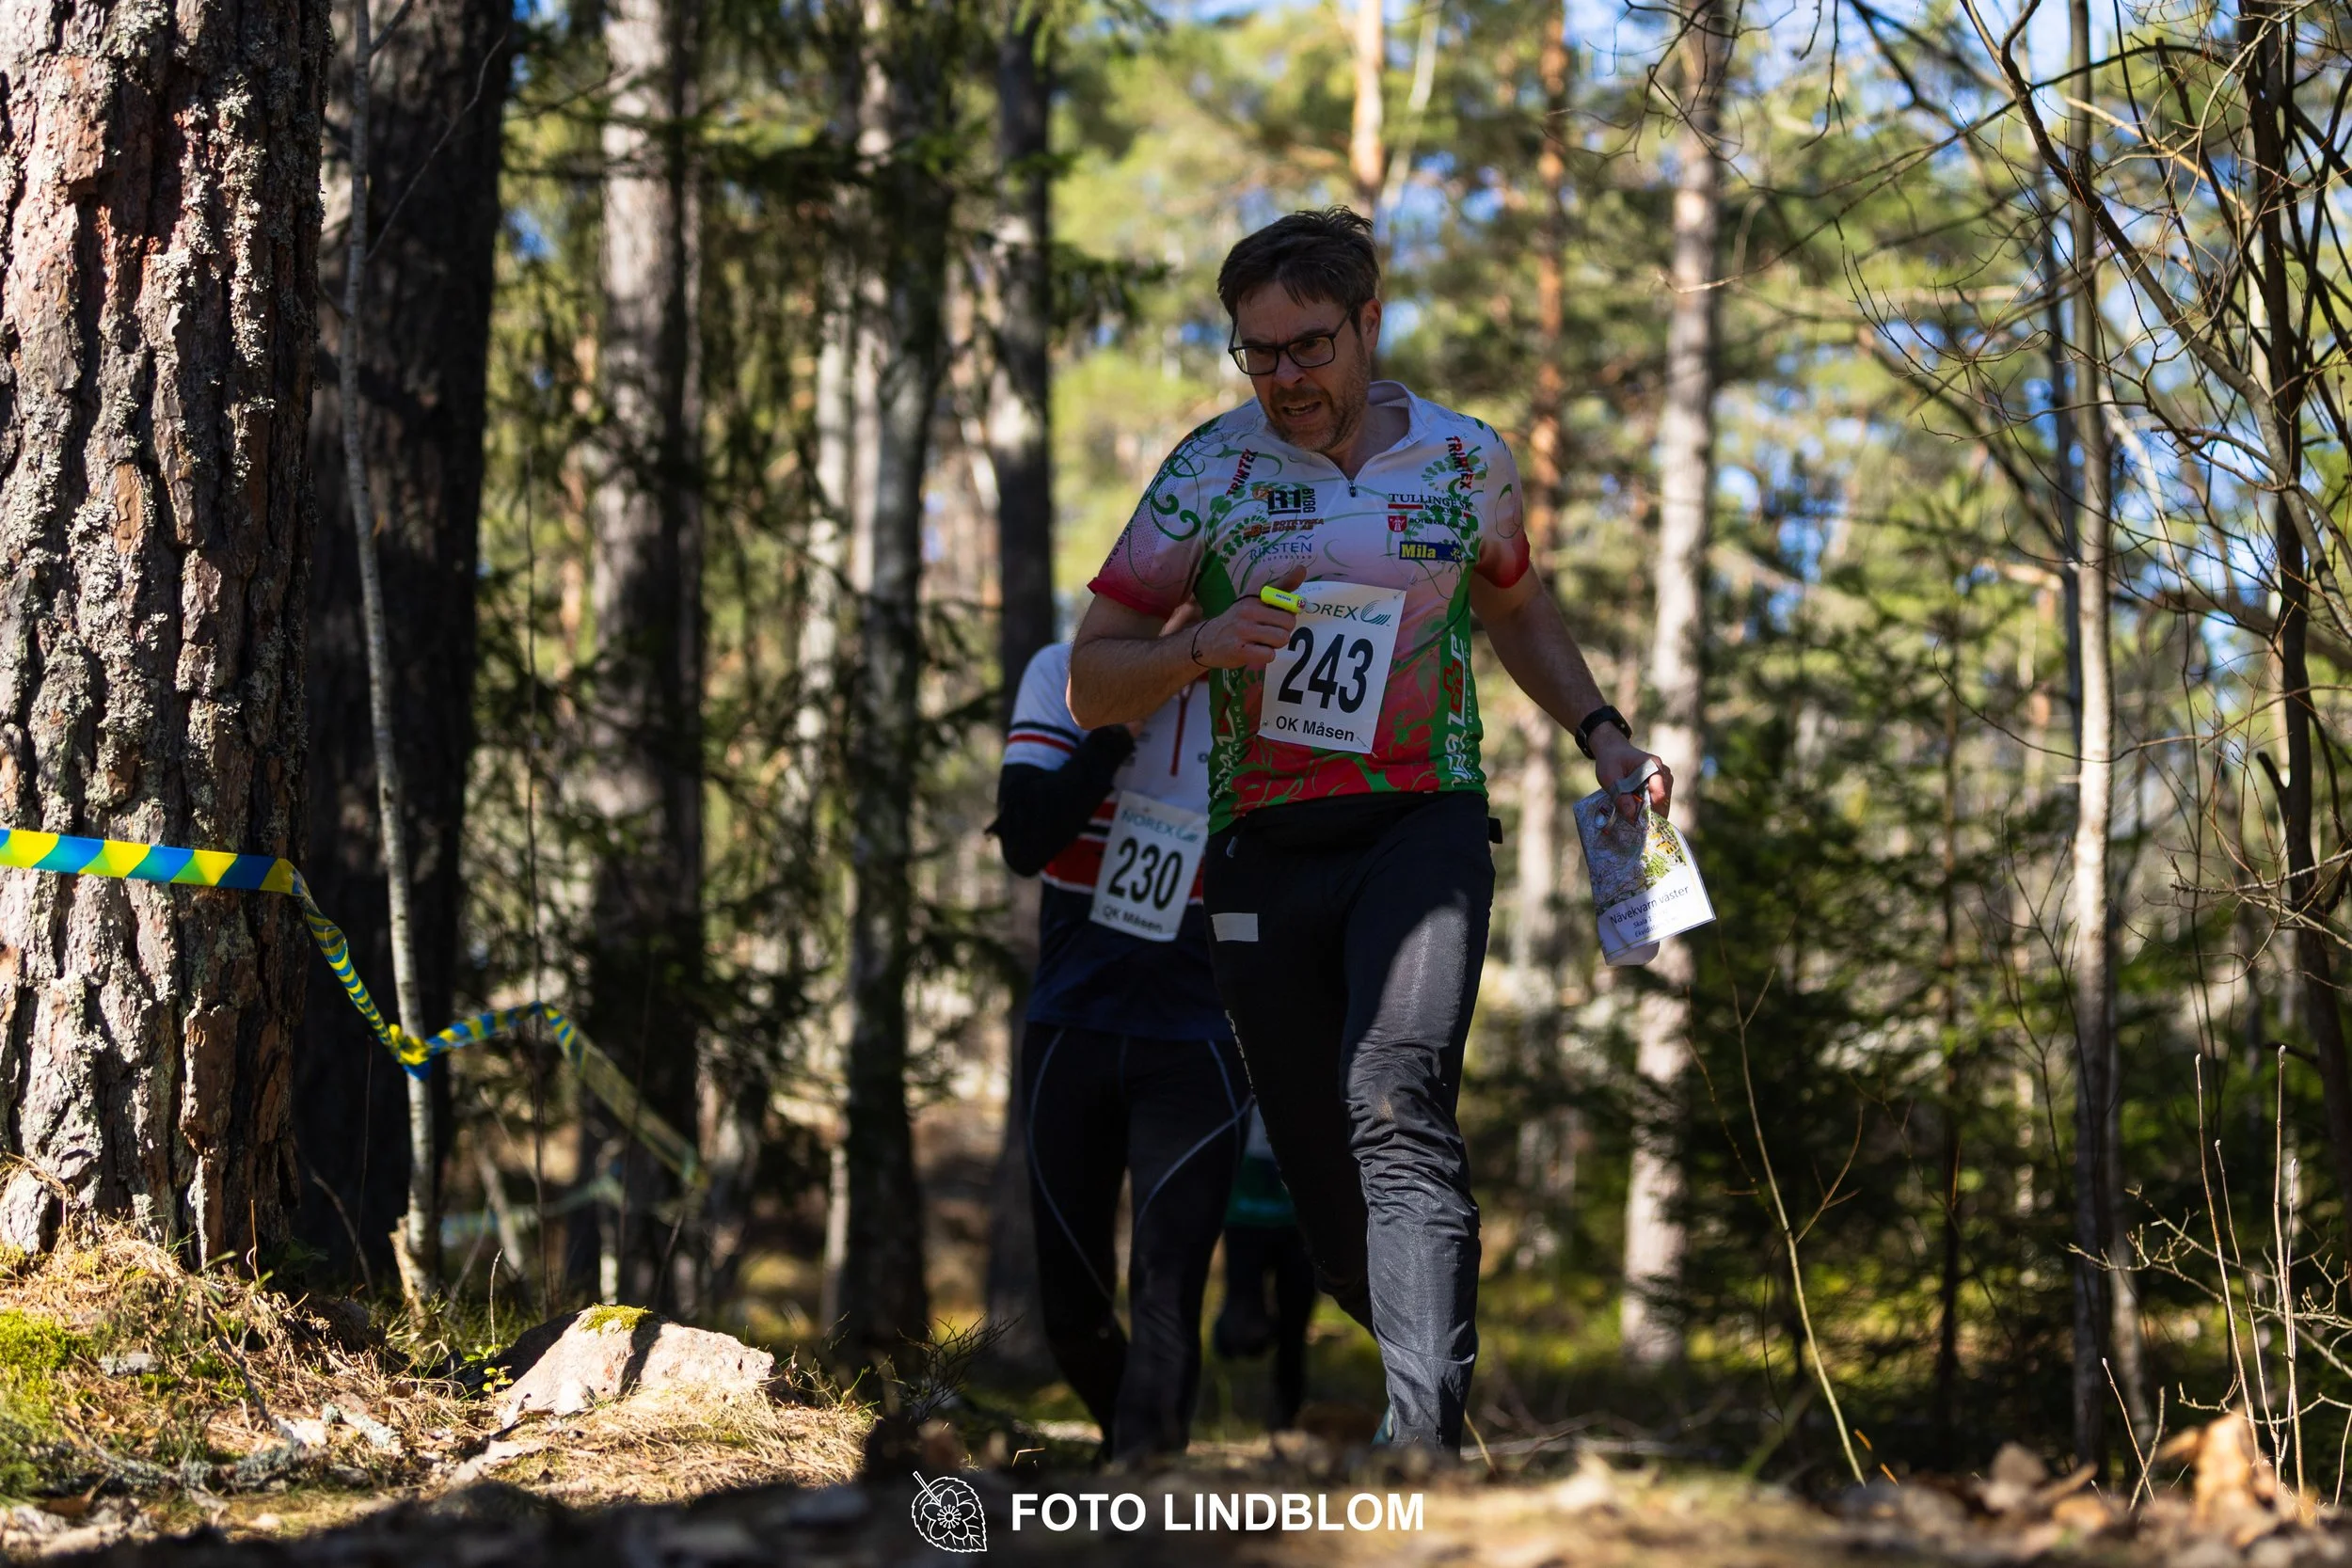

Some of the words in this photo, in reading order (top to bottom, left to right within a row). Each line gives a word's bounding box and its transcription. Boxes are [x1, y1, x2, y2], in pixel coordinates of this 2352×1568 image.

[1302, 488, 1316, 514] BYGG
[1249, 542, 1312, 561] RIKSTEN
[1401, 544, 1437, 559] Mila
[1305, 602, 1359, 622] OREX
[1278, 626, 1374, 714] 243
[1276, 716, 1299, 732] OK
[1303, 720, 1355, 742] Måsen
[1121, 808, 1174, 837] NOREX
[1108, 836, 1183, 911] 230
[1610, 899, 1658, 926] Nävekvarn
[1659, 886, 1690, 905] väster
